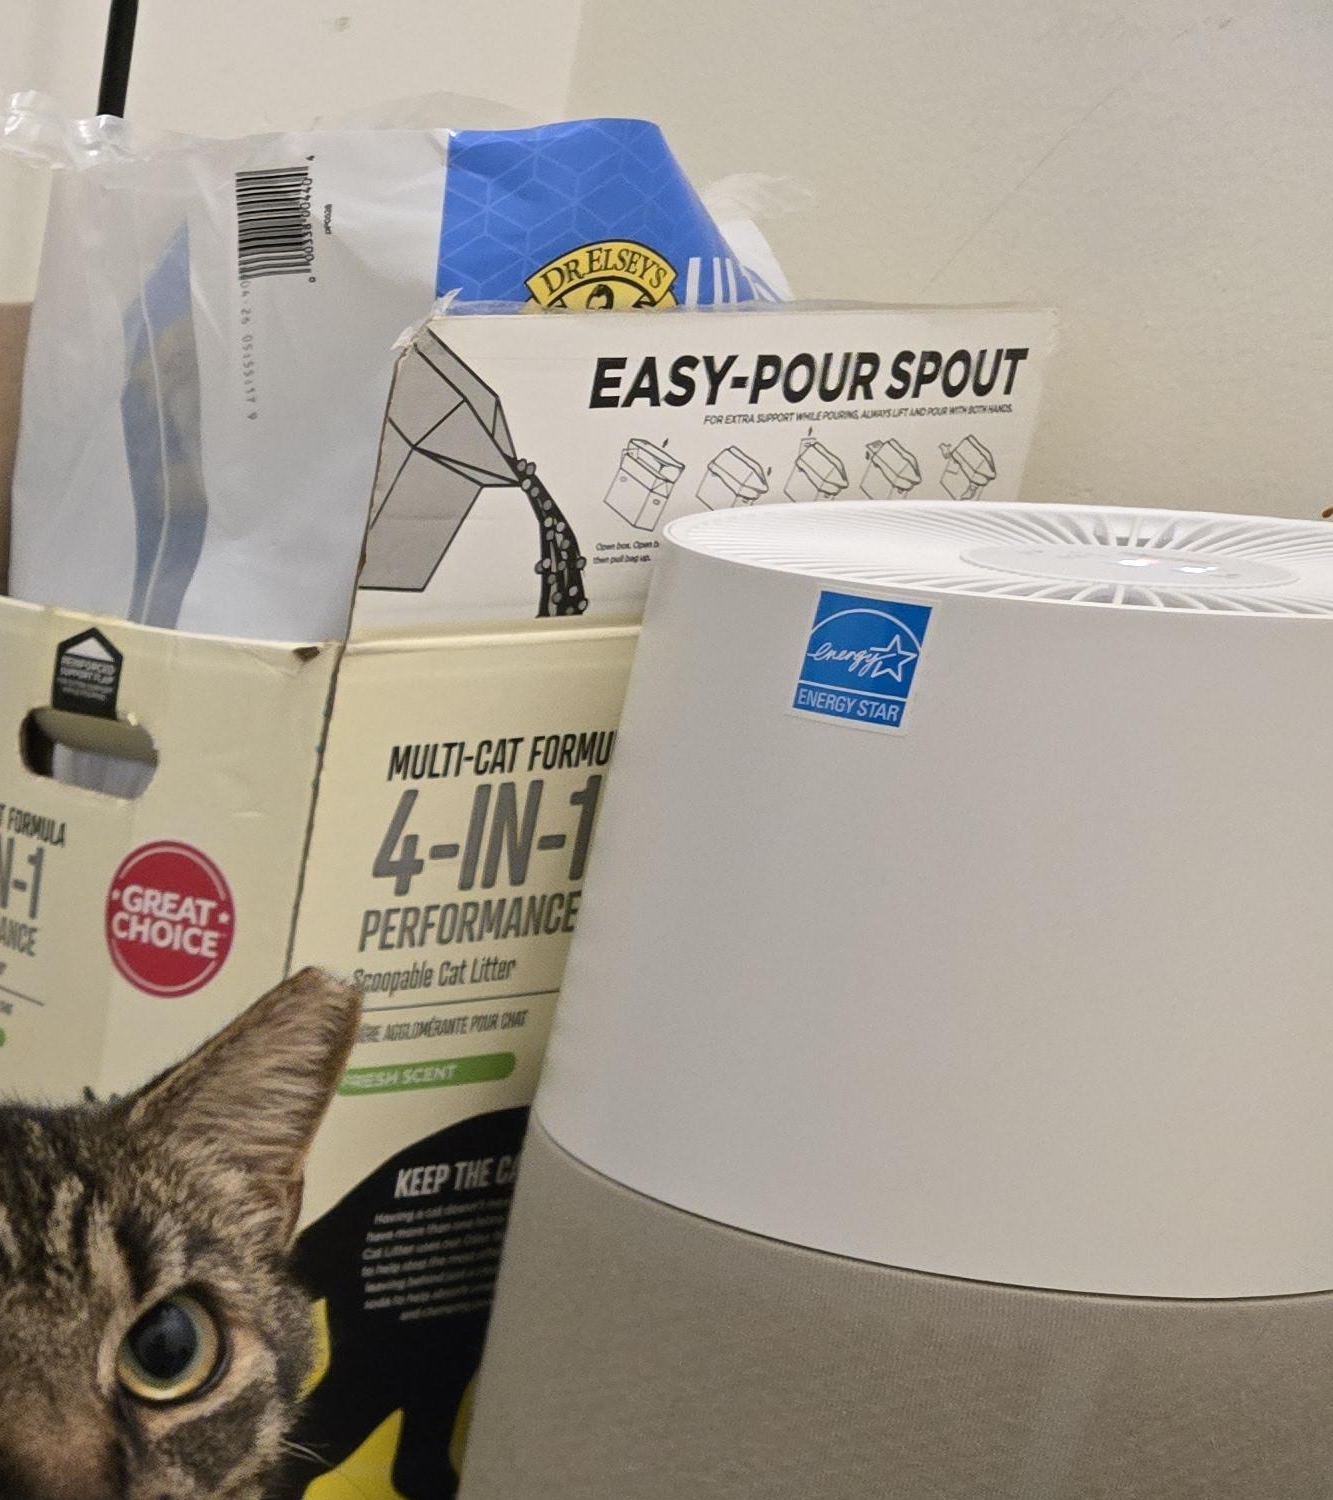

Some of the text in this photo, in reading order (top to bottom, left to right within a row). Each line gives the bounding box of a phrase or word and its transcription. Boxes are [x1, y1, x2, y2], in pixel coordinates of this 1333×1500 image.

[586, 246, 668, 290] ELSEY'S
[589, 348, 1029, 409] EASY-POUR SPOUT
[703, 414, 724, 425] FOR
[724, 413, 755, 425] EXTRA
[756, 412, 795, 424] SUPPORT
[796, 410, 822, 421] WHILE
[927, 406, 948, 417] POUR
[797, 688, 900, 722] ENERGY STAR
[387, 729, 617, 782] MULTI-CAT FORMU
[7, 806, 67, 848] FORMULA
[372, 774, 603, 897] 4-IN-1
[121, 884, 219, 928] GREAT
[358, 890, 582, 952] PERFORMANCE
[112, 911, 220, 960] CHOICE
[438, 959, 468, 988] Cat
[469, 956, 517, 984] Litter
[469, 1011, 498, 1035] POUR
[394, 1163, 451, 1199] KEEP
[453, 1157, 494, 1191] THE
